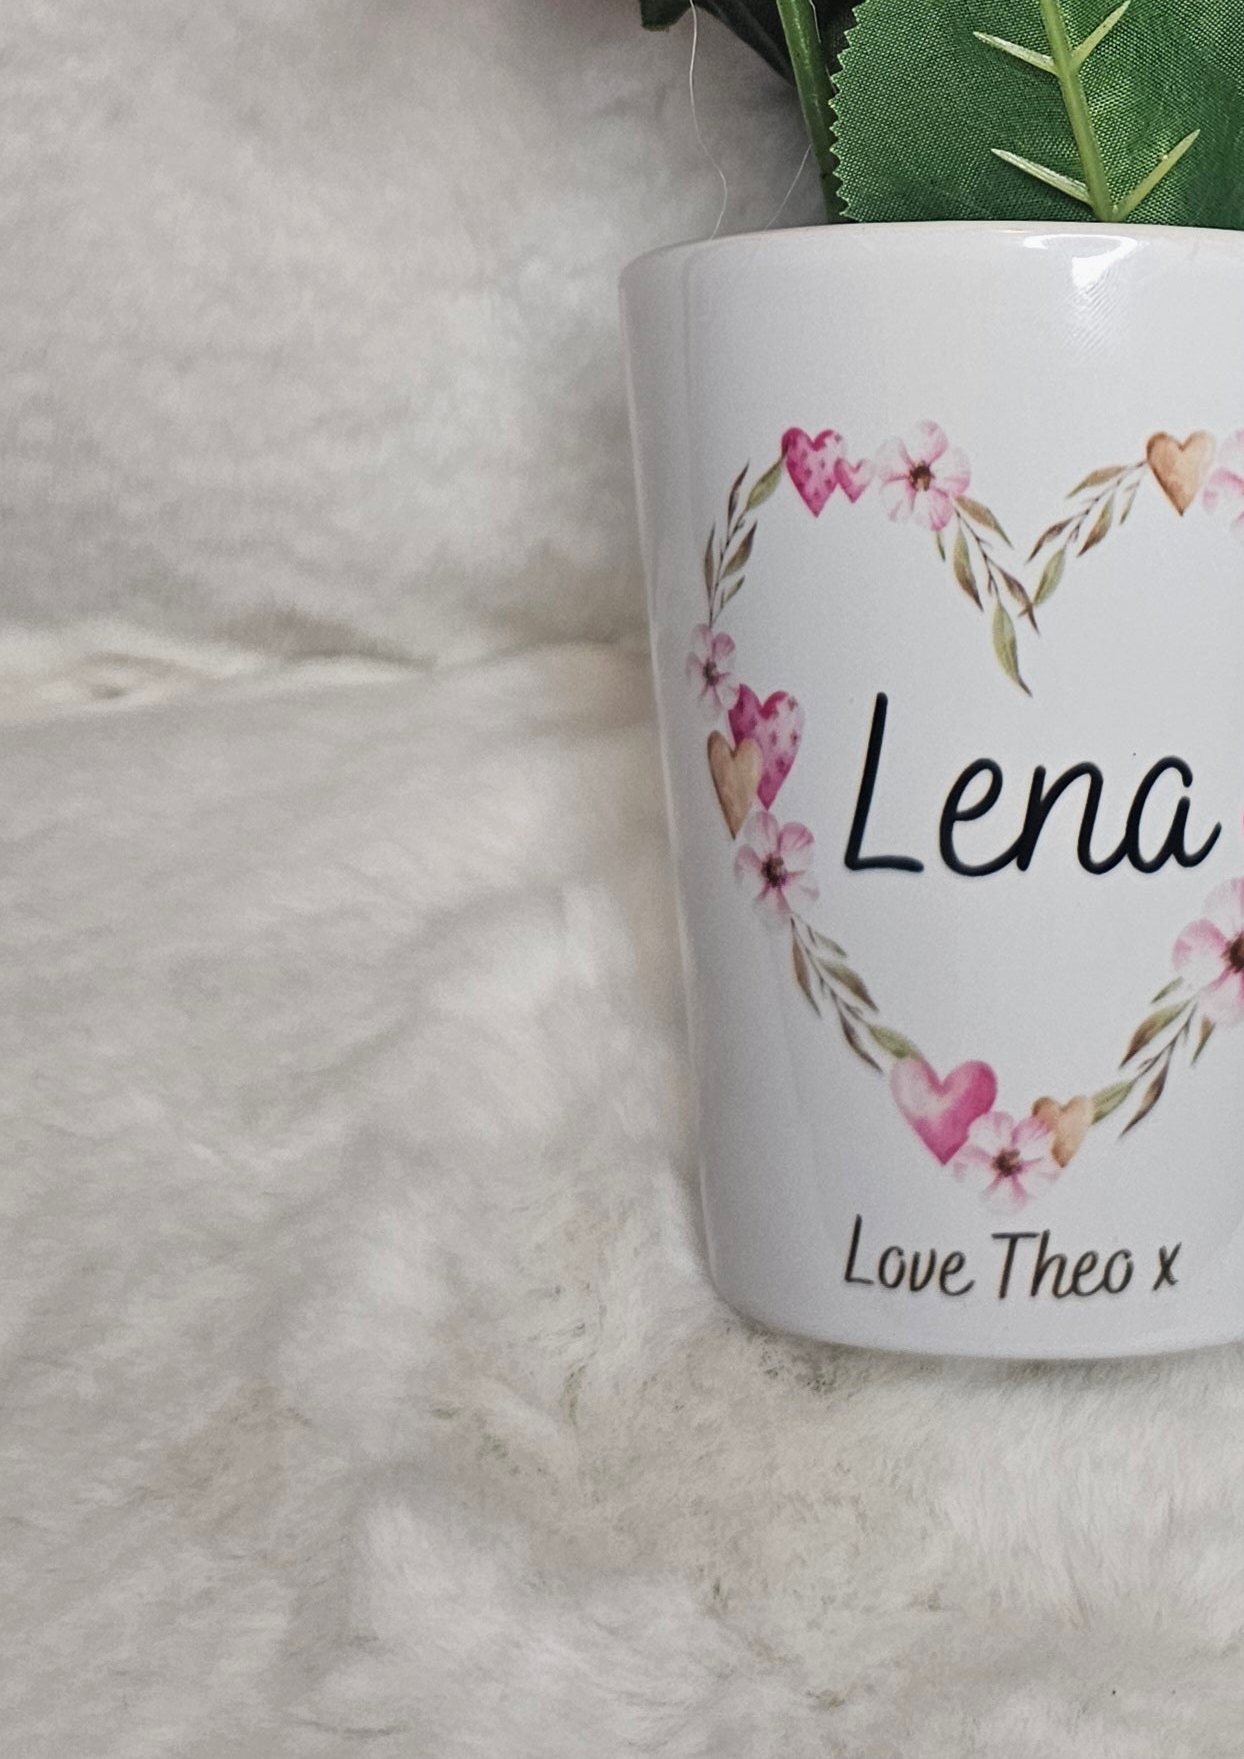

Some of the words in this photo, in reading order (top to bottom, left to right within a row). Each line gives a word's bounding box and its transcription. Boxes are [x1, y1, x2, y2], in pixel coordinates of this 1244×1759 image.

[842, 690, 1223, 879] Lena
[841, 1212, 978, 1299] Love
[990, 1228, 1135, 1302] Theo
[1151, 1241, 1183, 1293] x
